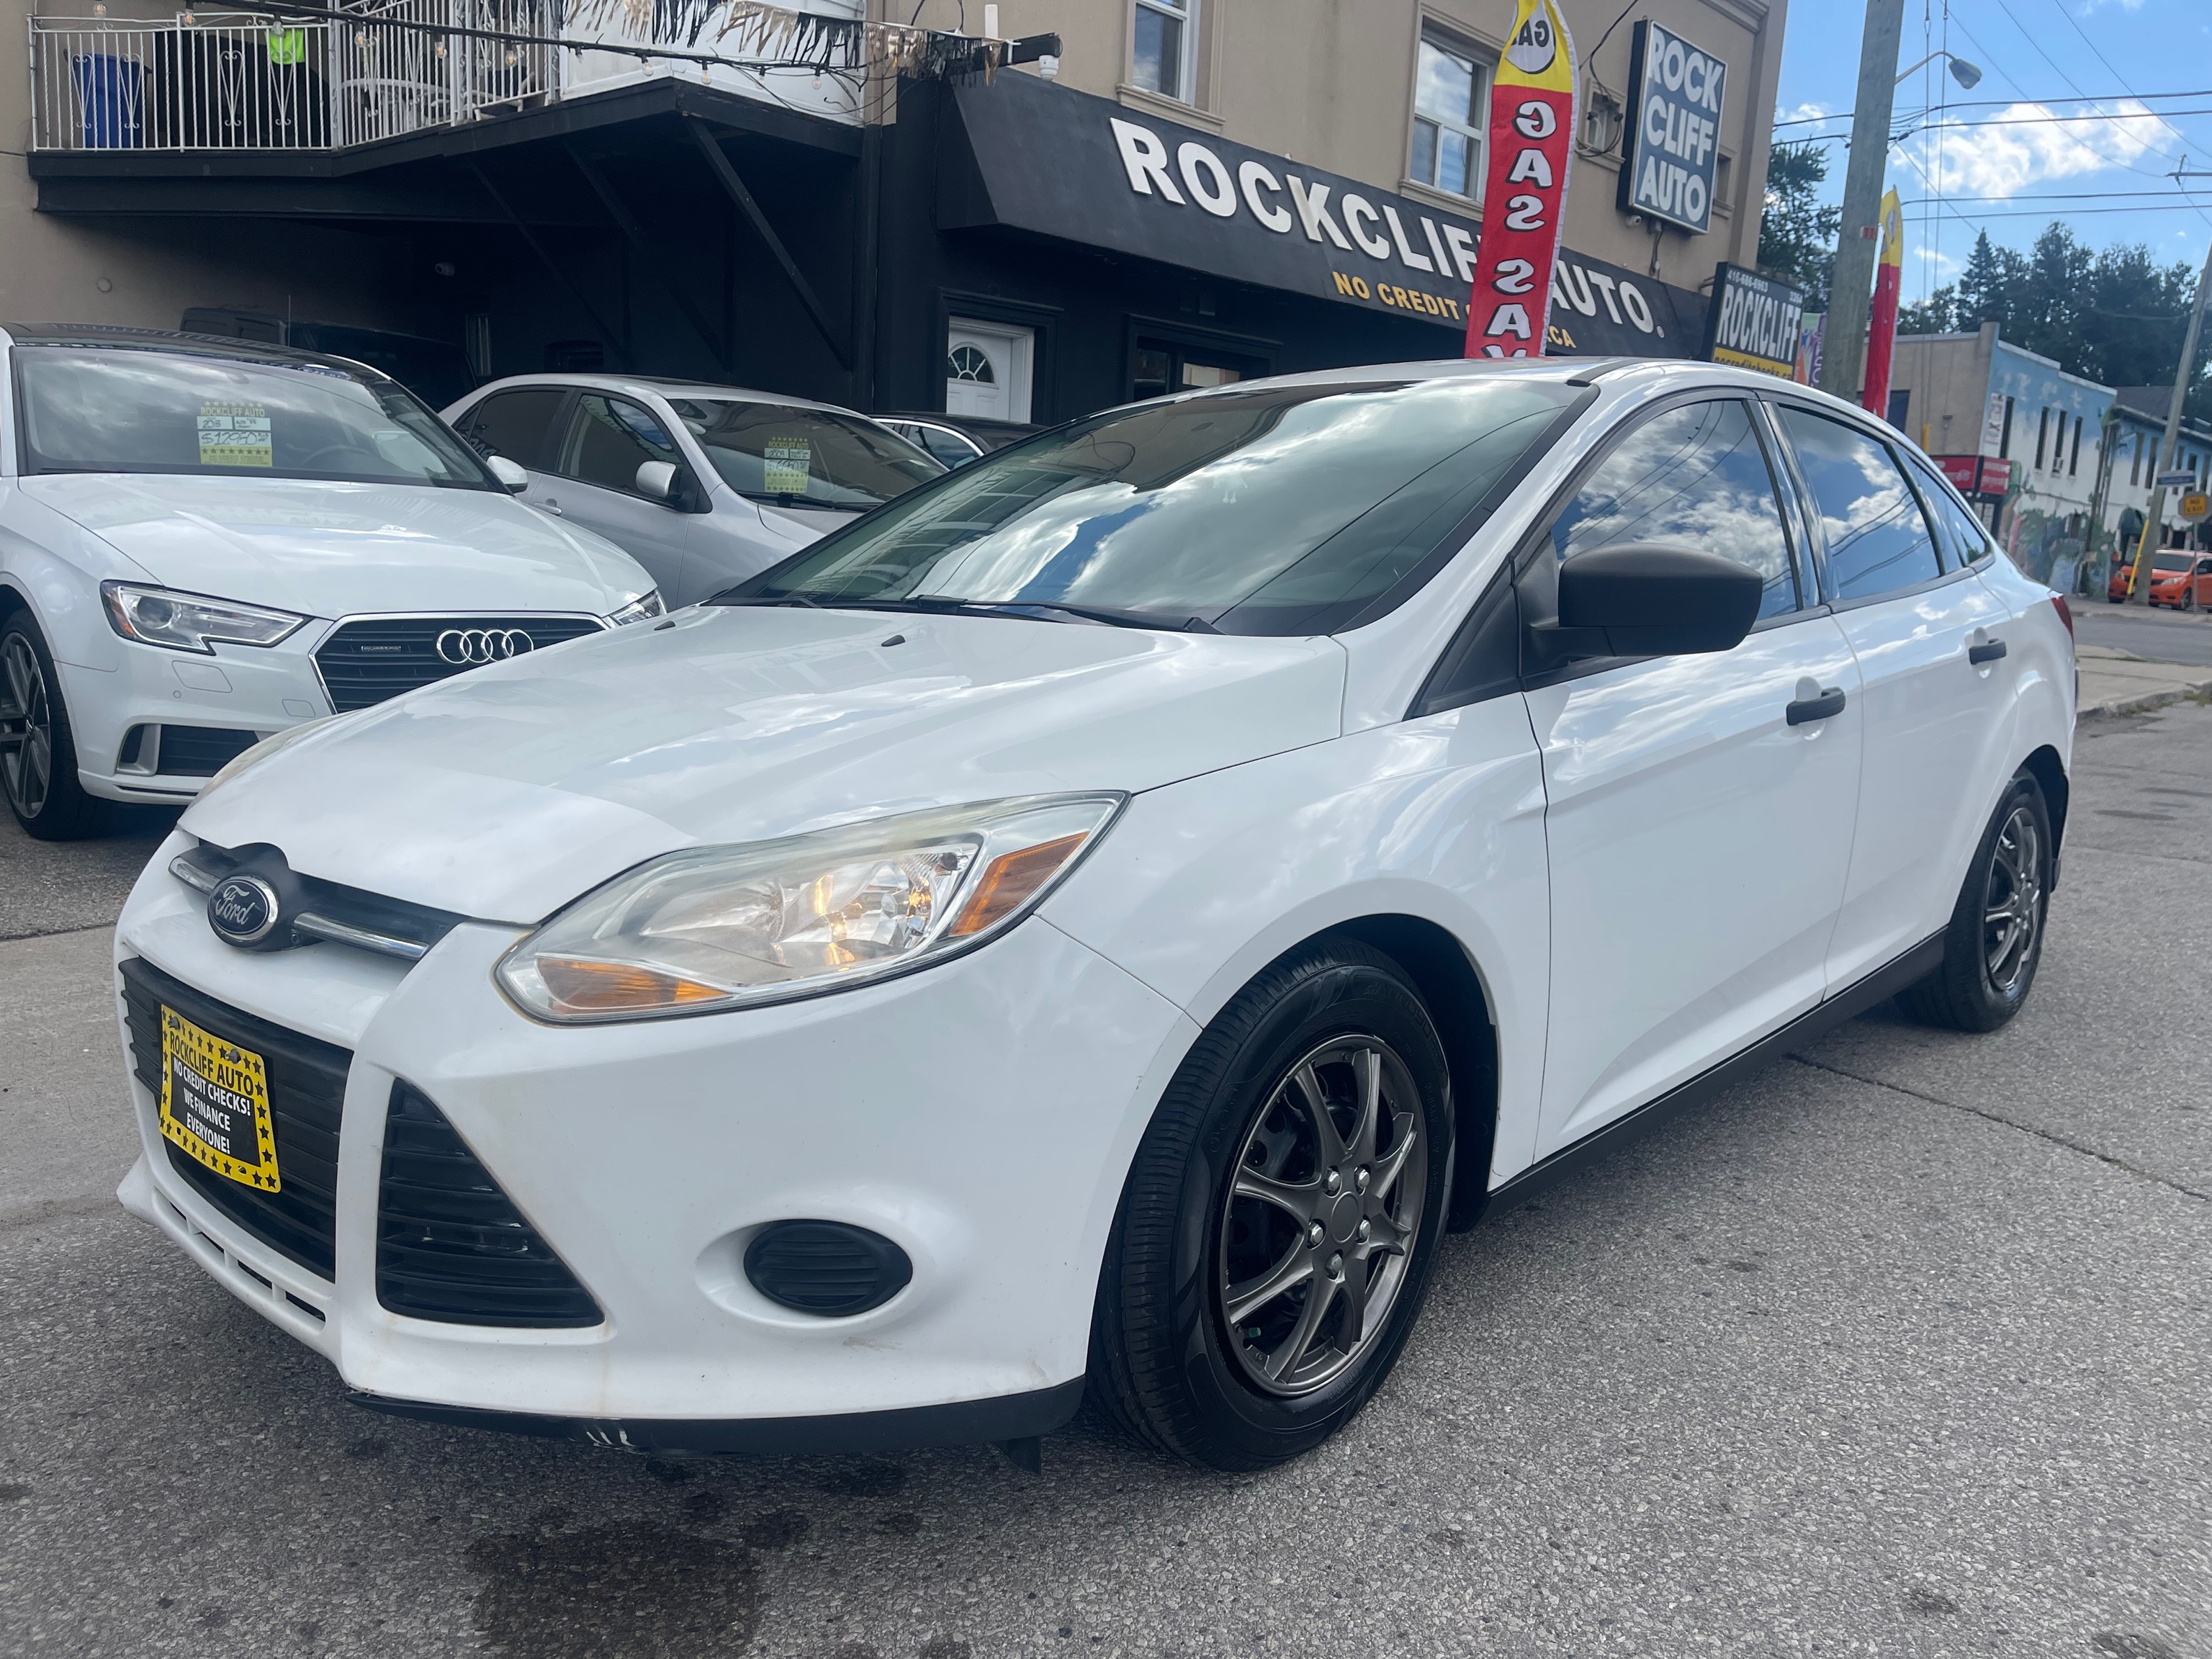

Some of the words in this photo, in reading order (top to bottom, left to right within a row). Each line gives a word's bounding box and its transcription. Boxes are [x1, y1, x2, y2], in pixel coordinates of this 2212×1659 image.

[1647, 28, 1724, 113] ROCK
[1646, 95, 1715, 166] CLIFF
[1110, 117, 1481, 283] ROCKCLIF
[1639, 156, 1707, 222] AUTO
[1333, 271, 1370, 300] NO
[1377, 283, 1460, 320] CREDIT
[1716, 284, 1802, 361] ROCKCLIFF
[201, 407, 242, 416] ROCKCLIFF
[245, 408, 265, 417] AUTO
[215, 885, 255, 925] Ford
[169, 1030, 214, 1078] ROCKCLIFF
[217, 1064, 253, 1096] AUTO
[174, 1056, 183, 1076] NO
[184, 1069, 207, 1095] CREDIT
[208, 1083, 251, 1116] CHECKS!
[184, 1087, 194, 1109] WE
[194, 1094, 230, 1131] FINANCE
[186, 1112, 230, 1154] EVERYONE!
